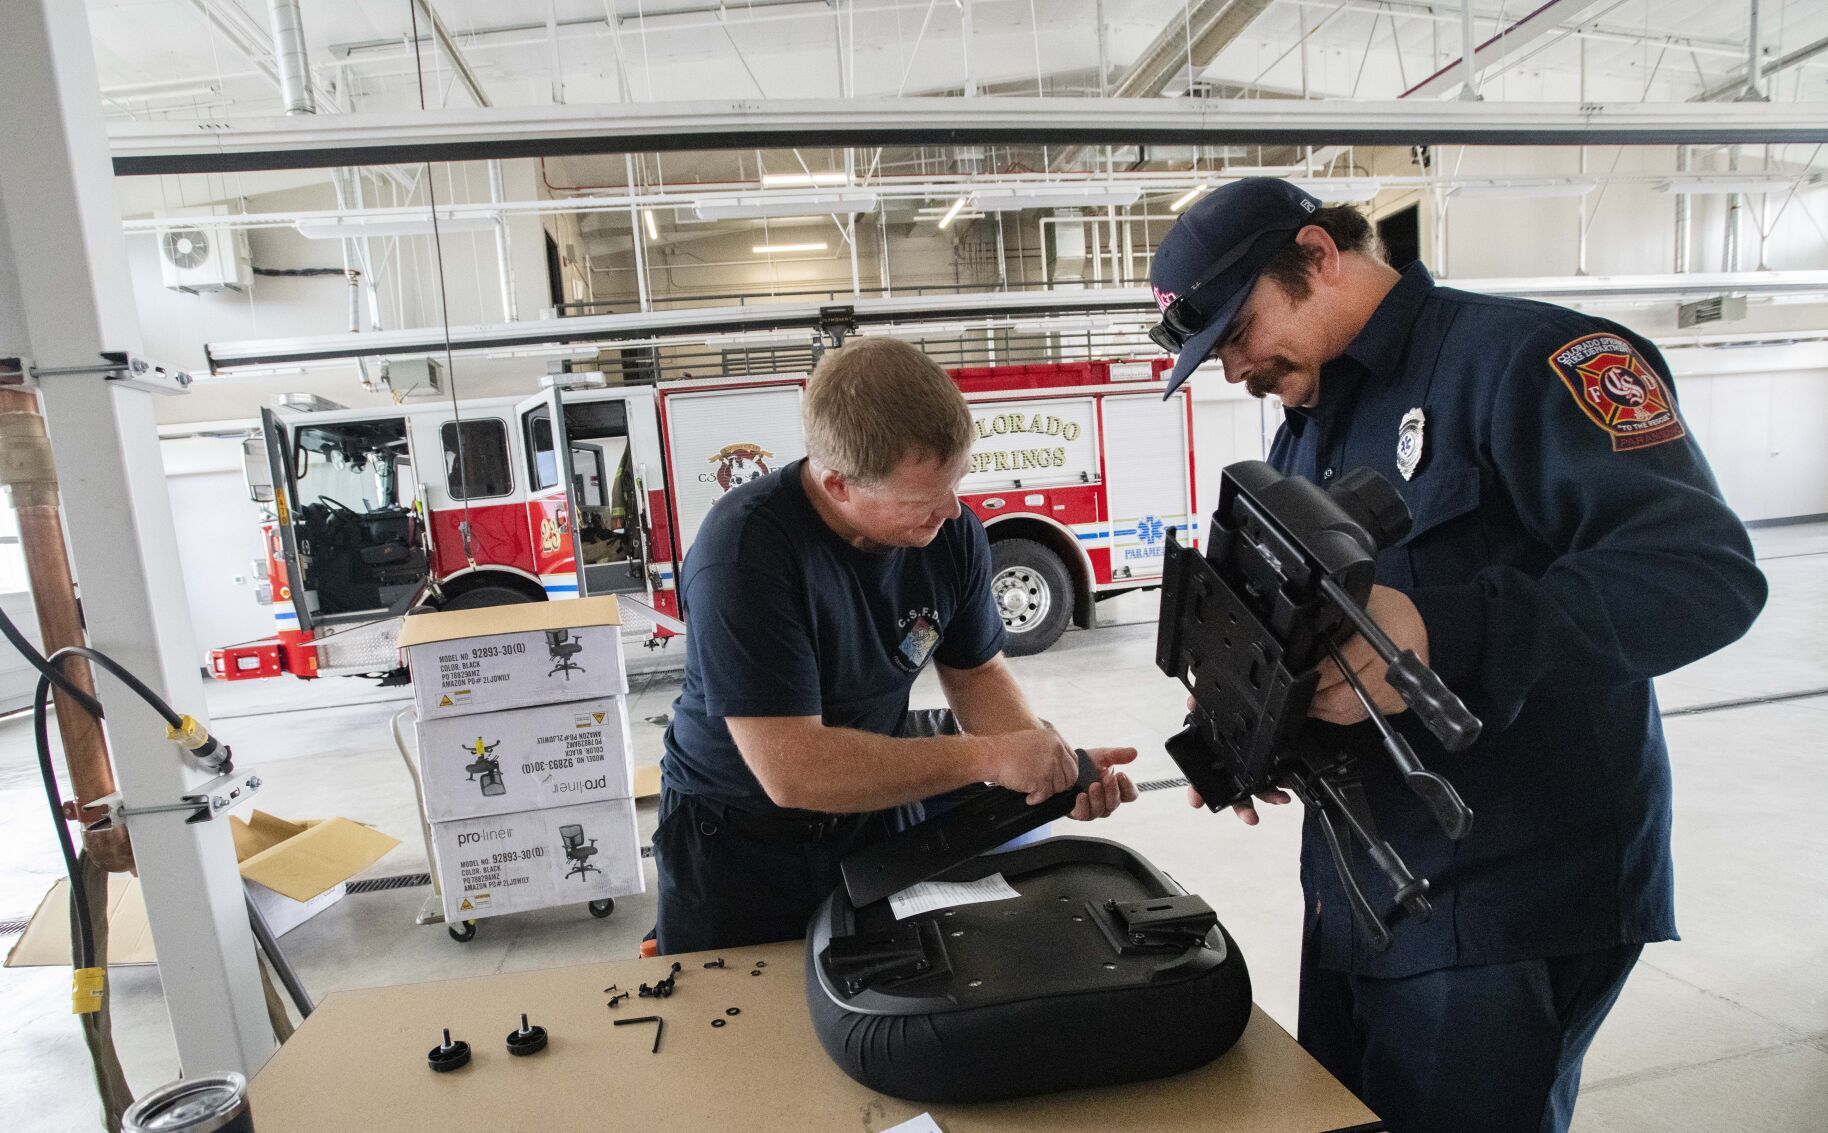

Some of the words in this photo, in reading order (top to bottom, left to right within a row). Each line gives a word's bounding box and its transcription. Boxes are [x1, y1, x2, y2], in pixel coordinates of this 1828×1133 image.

[1557, 338, 1601, 363] COLORADO
[1564, 352, 1584, 367] FIRE
[1588, 385, 1601, 403] F
[974, 413, 1081, 441] LORADO
[1632, 421, 1648, 430] THE
[1125, 546, 1166, 560] PARAME
[438, 655, 459, 663] MODEL
[460, 653, 471, 661] NO.
[440, 664, 461, 673] COLOR:
[462, 661, 480, 670] BLACK
[442, 678, 466, 688] AMAZON
[579, 731, 602, 740] AMAZON
[565, 749, 583, 757] BLACK
[585, 746, 604, 754] COLOR:
[587, 754, 604, 763] MODEL
[460, 860, 480, 869] MODEL
[461, 868, 482, 877] COLOR:
[483, 865, 501, 874] BLACK
[464, 883, 487, 892] AMAZON
